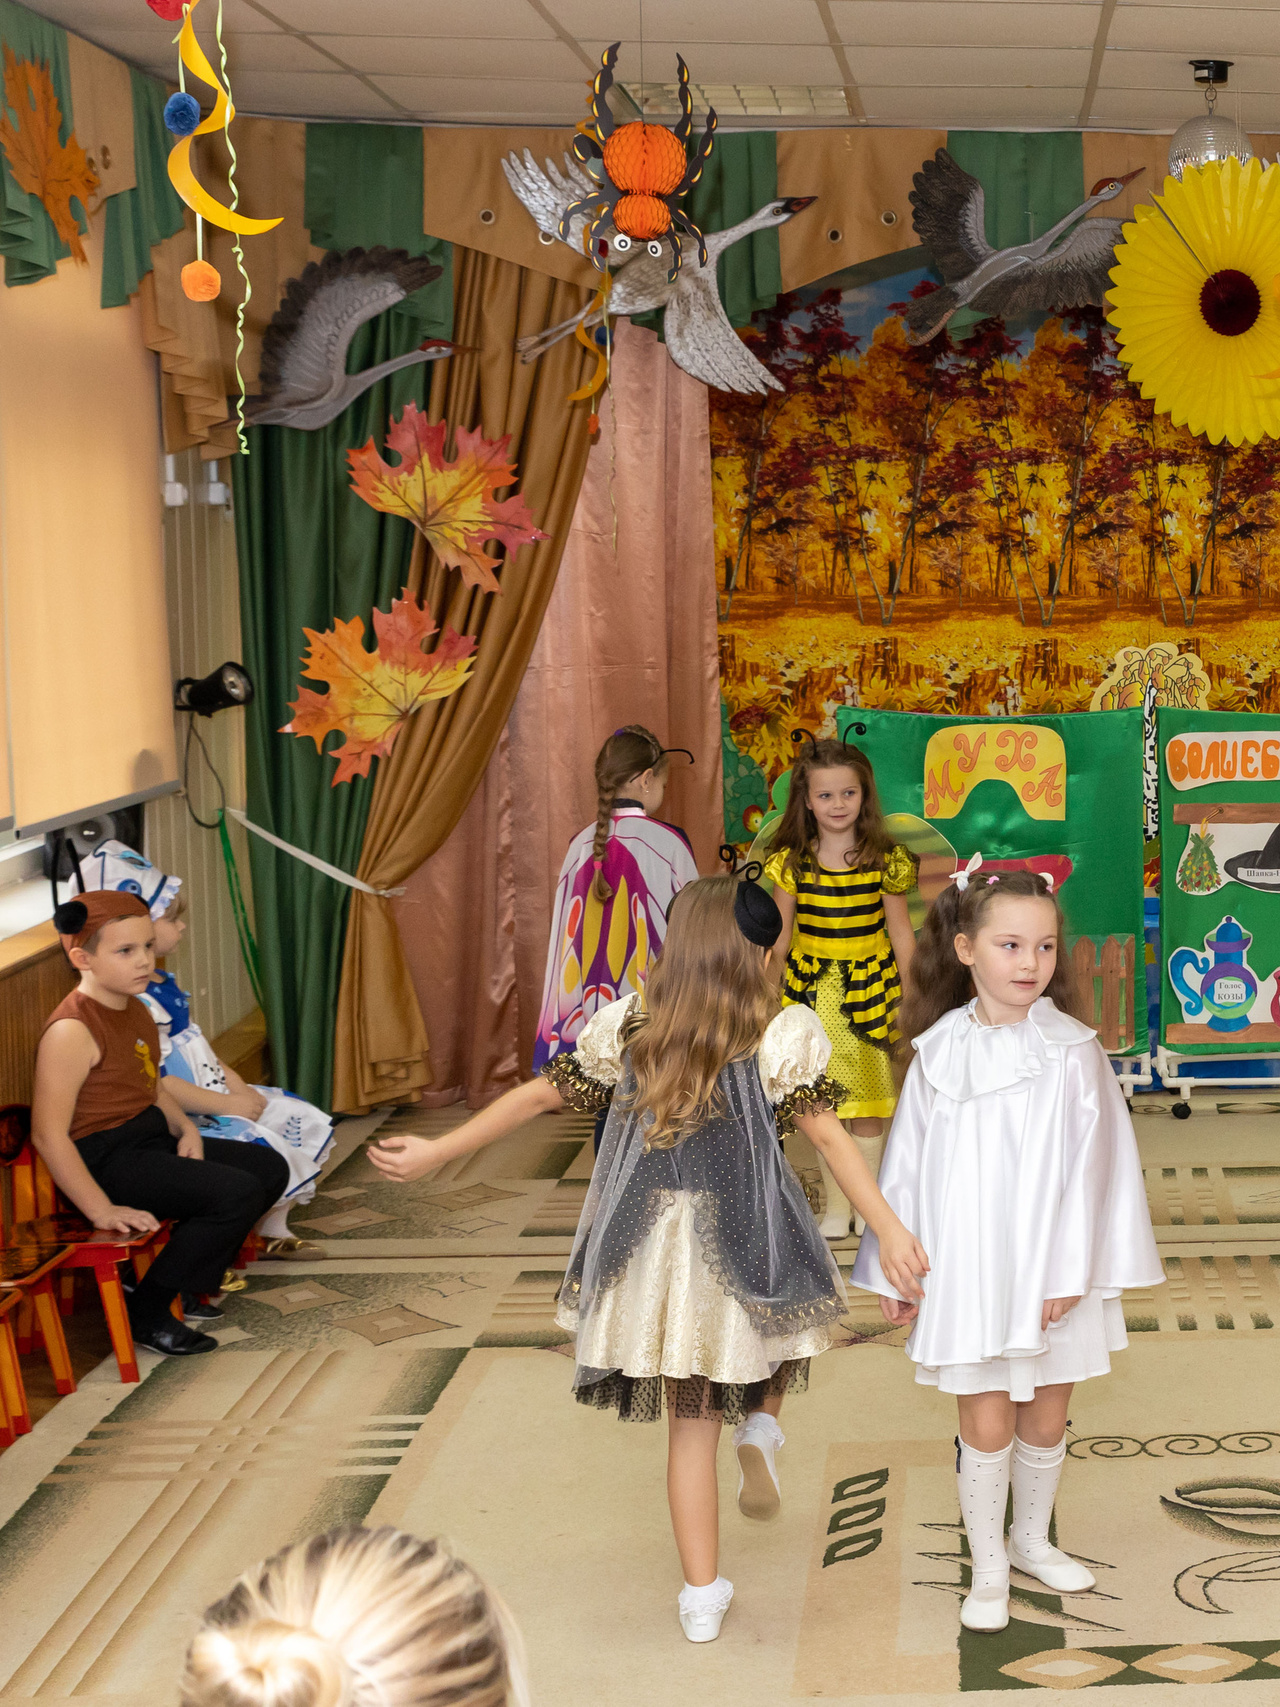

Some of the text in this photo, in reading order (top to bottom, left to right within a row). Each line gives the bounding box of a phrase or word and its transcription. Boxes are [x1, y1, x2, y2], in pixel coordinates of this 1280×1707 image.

[924, 730, 1063, 817] МУХА
[1219, 982, 1242, 990] Голос
[1217, 993, 1243, 1001] КОЗЫ
